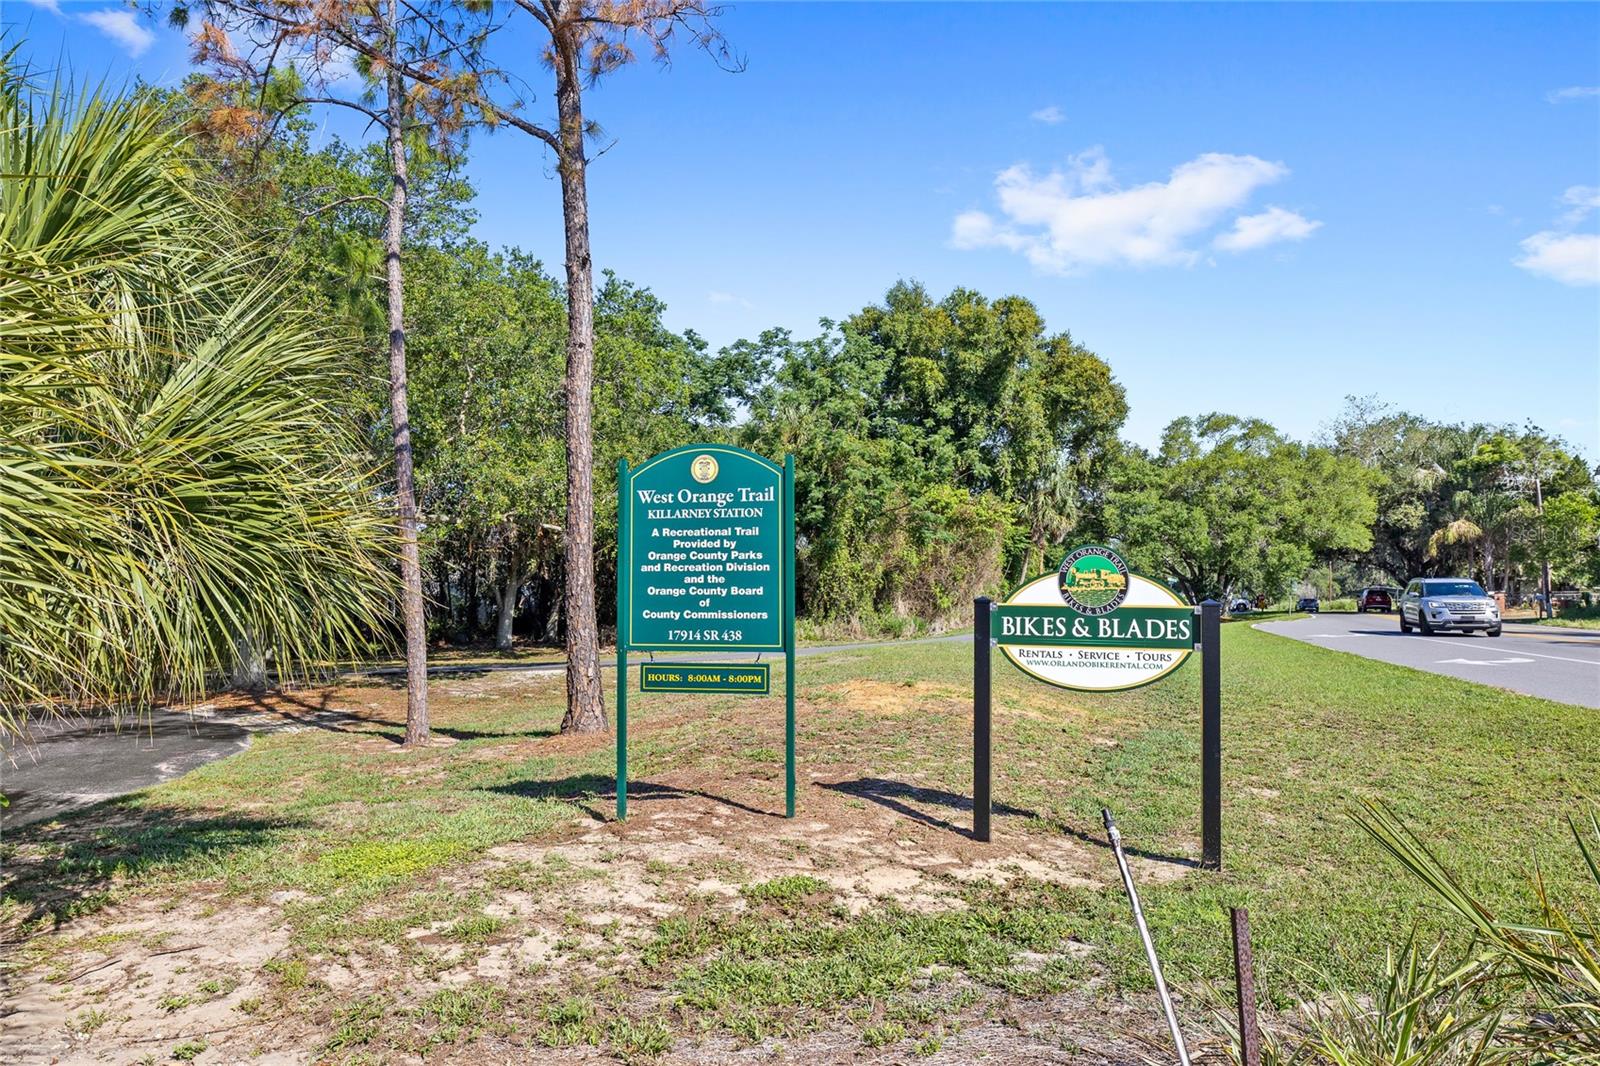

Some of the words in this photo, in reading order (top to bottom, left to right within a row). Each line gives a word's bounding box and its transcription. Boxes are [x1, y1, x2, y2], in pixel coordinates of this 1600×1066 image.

[637, 490, 674, 504] West
[677, 489, 735, 507] Orange
[737, 486, 775, 502] Trail
[648, 509, 712, 519] KILLARNEY
[713, 508, 763, 518] STATION
[651, 528, 660, 537] A
[662, 527, 732, 537] Recreational
[734, 527, 759, 536] Trail
[673, 539, 721, 548] Provided
[723, 539, 737, 550] by
[648, 551, 687, 562] Orange
[689, 551, 728, 562] County
[731, 551, 763, 560] Parks
[1060, 557, 1076, 573] WEST
[1076, 548, 1109, 557] ORANGE
[1110, 555, 1127, 575] TRAIL
[641, 563, 661, 572] and
[663, 563, 723, 572] Recreation
[726, 562, 770, 571] Division
[684, 575, 705, 584] and
[707, 575, 726, 584] the
[647, 586, 686, 597] Orange
[689, 586, 728, 597] County
[730, 586, 764, 595] Board
[699, 598, 710, 607] of
[1062, 592, 1083, 613] BIKES
[1085, 607, 1092, 615] &
[1095, 593, 1125, 615] BLADES
[642, 610, 680, 621] County
[683, 610, 768, 620] Commissioners
[1001, 616, 1067, 636] BIKES
[1071, 617, 1092, 638] &
[1097, 618, 1191, 640] BLADES
[667, 630, 701, 641] 17914
[703, 630, 719, 641] SR
[721, 630, 743, 641] 438
[1026, 660, 1163, 670] WWW.ORLANDOBIKERENTAL.COM
[648, 673, 683, 682] HOURS:
[687, 674, 721, 683] 8:00AM
[728, 674, 762, 683] 8:00PM
